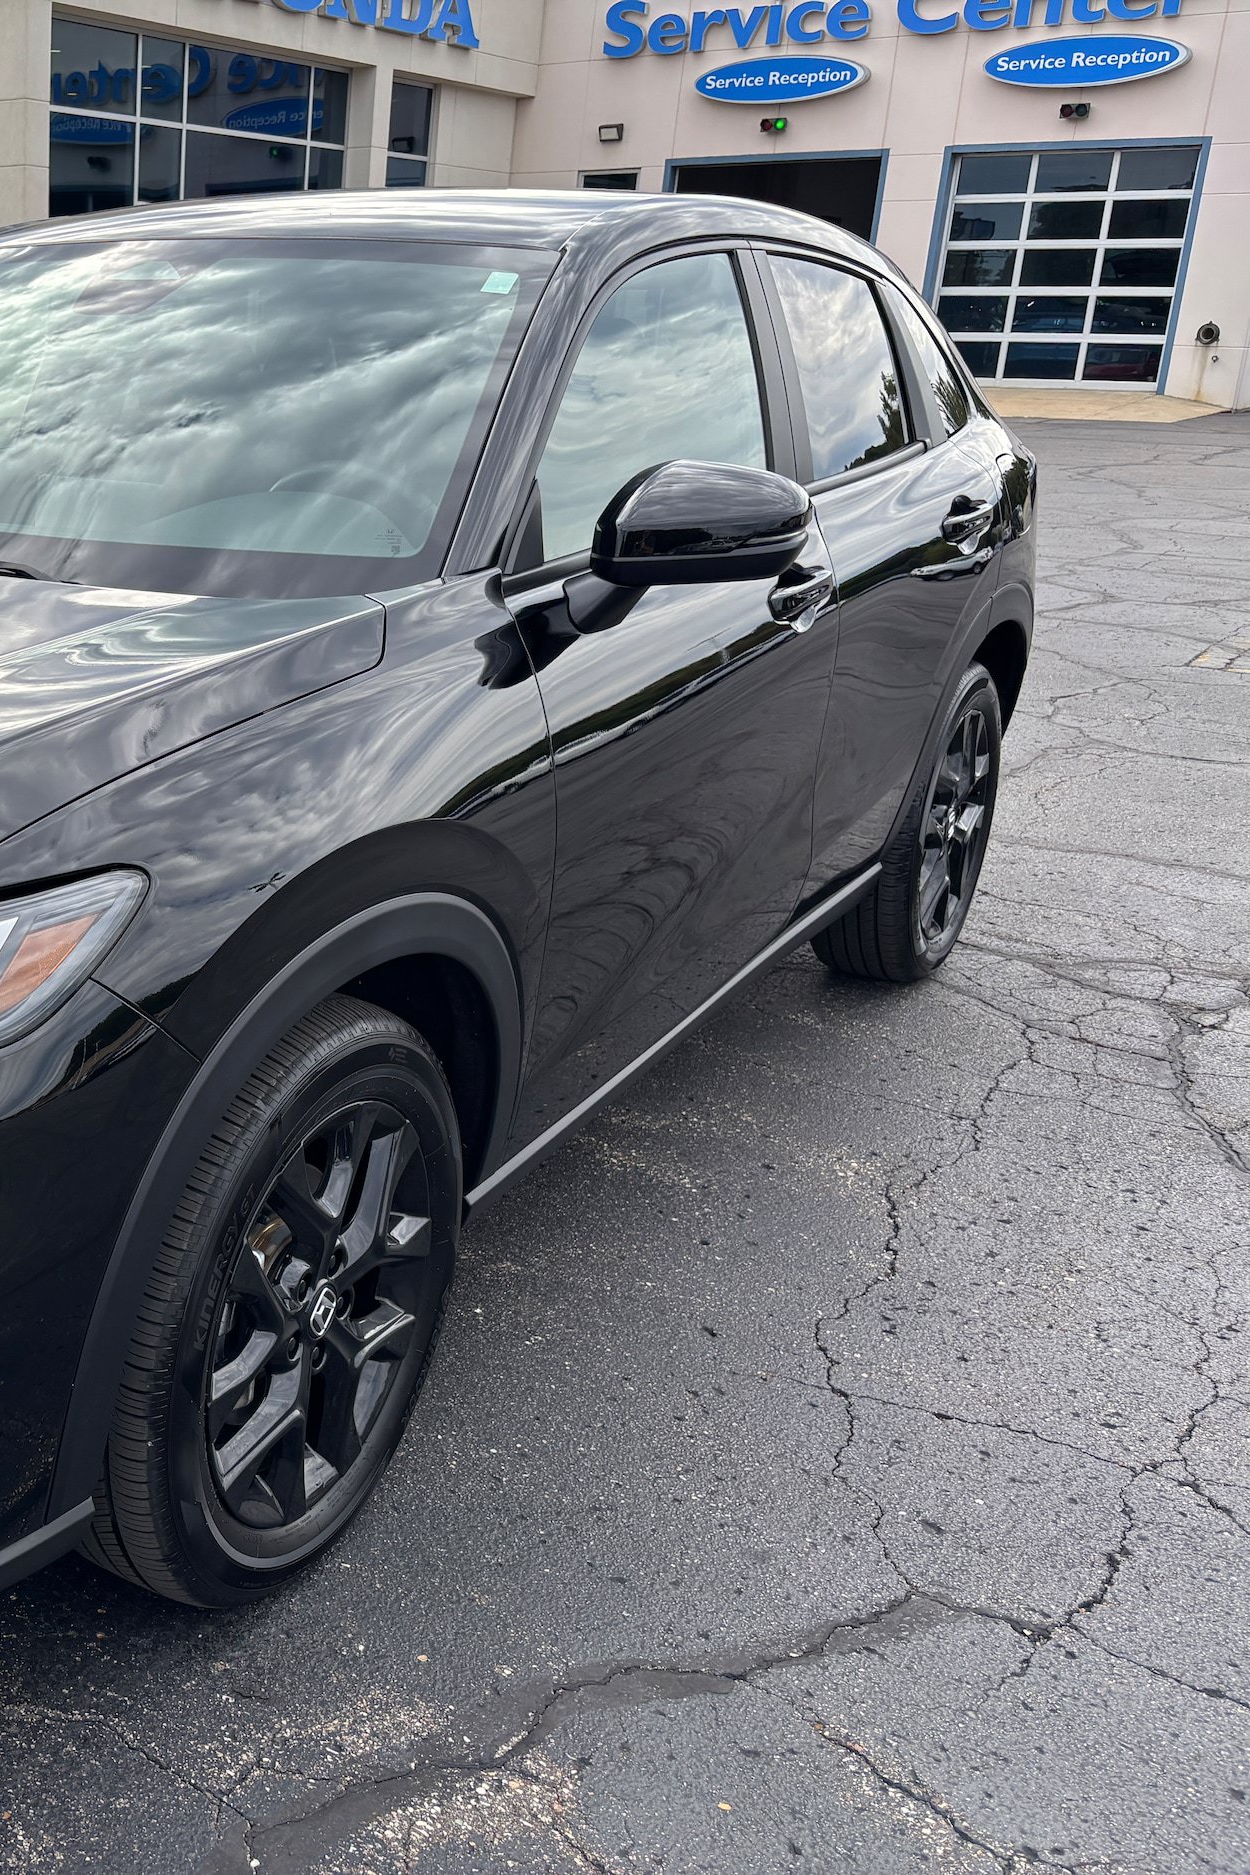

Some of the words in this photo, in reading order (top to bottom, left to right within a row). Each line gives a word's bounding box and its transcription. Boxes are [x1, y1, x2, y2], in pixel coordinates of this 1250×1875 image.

[602, 0, 871, 58] Service
[704, 72, 764, 90] Service
[768, 68, 851, 87] Reception
[996, 54, 1066, 72] Service
[1071, 49, 1171, 69] Reception
[194, 1212, 240, 1352] KINERGY
